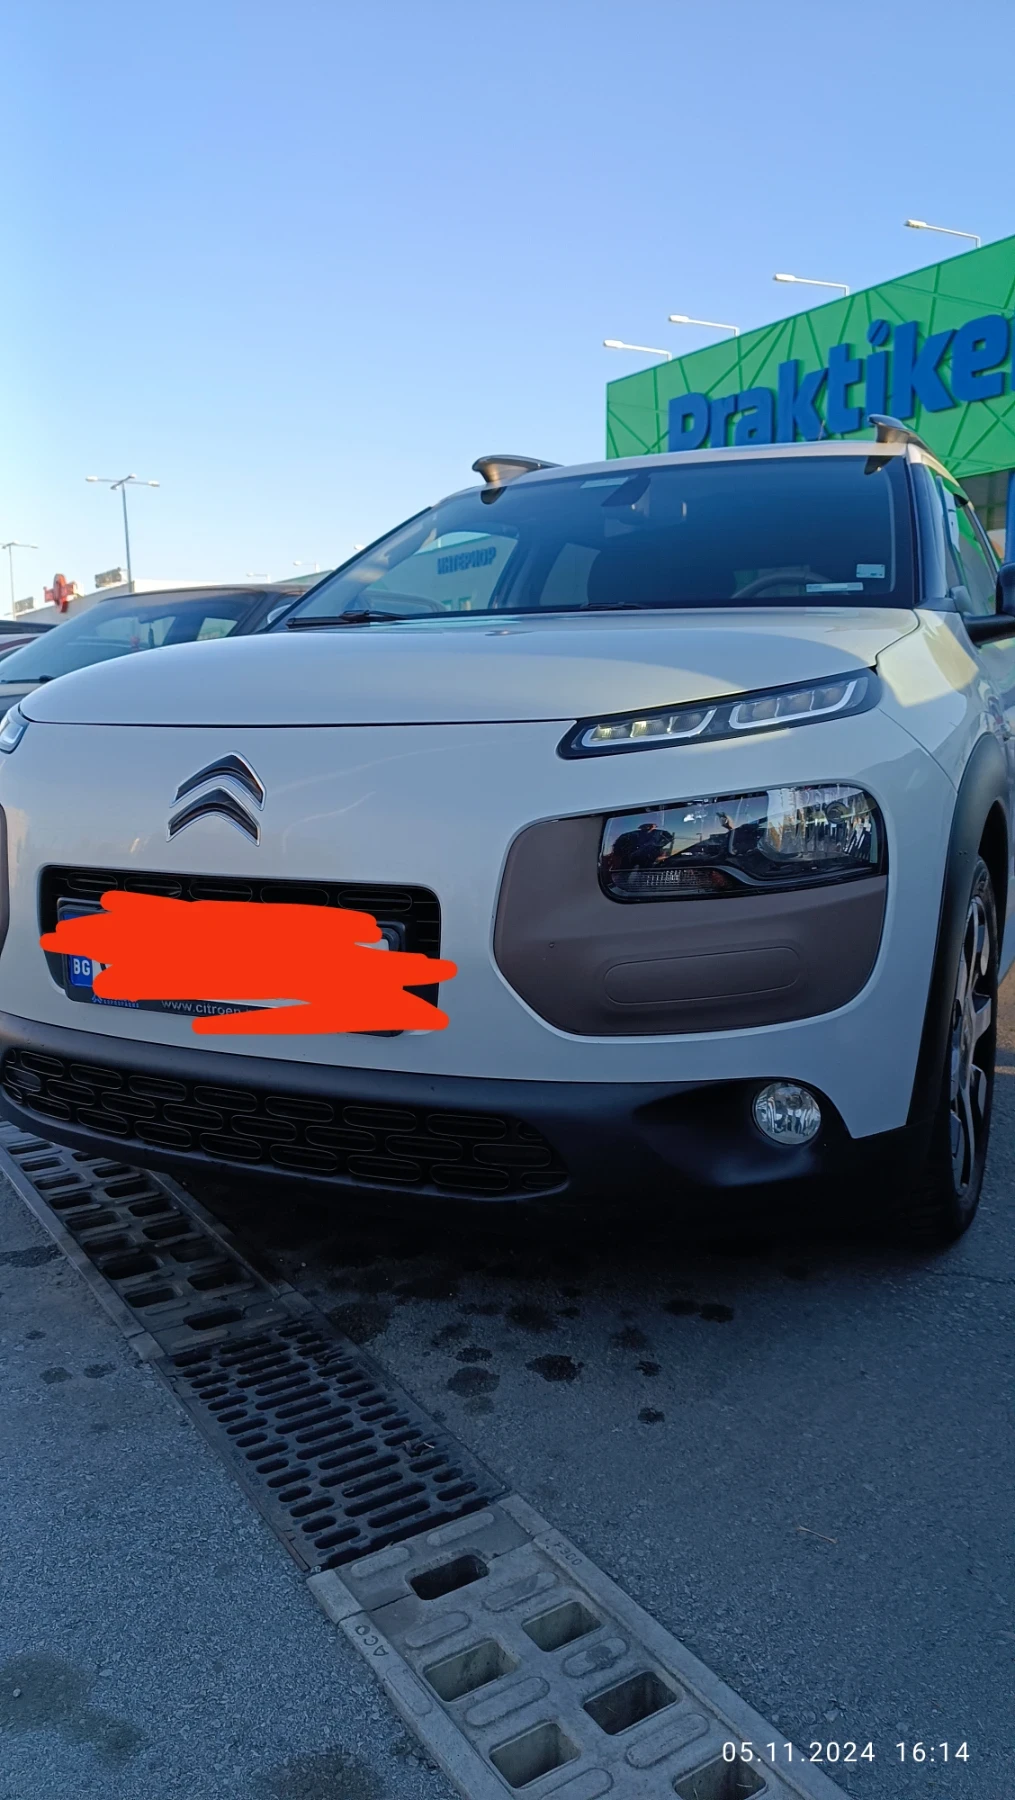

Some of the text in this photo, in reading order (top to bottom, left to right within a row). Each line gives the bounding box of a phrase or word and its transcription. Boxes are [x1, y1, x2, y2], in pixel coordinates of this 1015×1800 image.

[73, 958, 91, 976] BG
[161, 1000, 249, 1016] www.citroen
[354, 1624, 390, 1657] ACO
